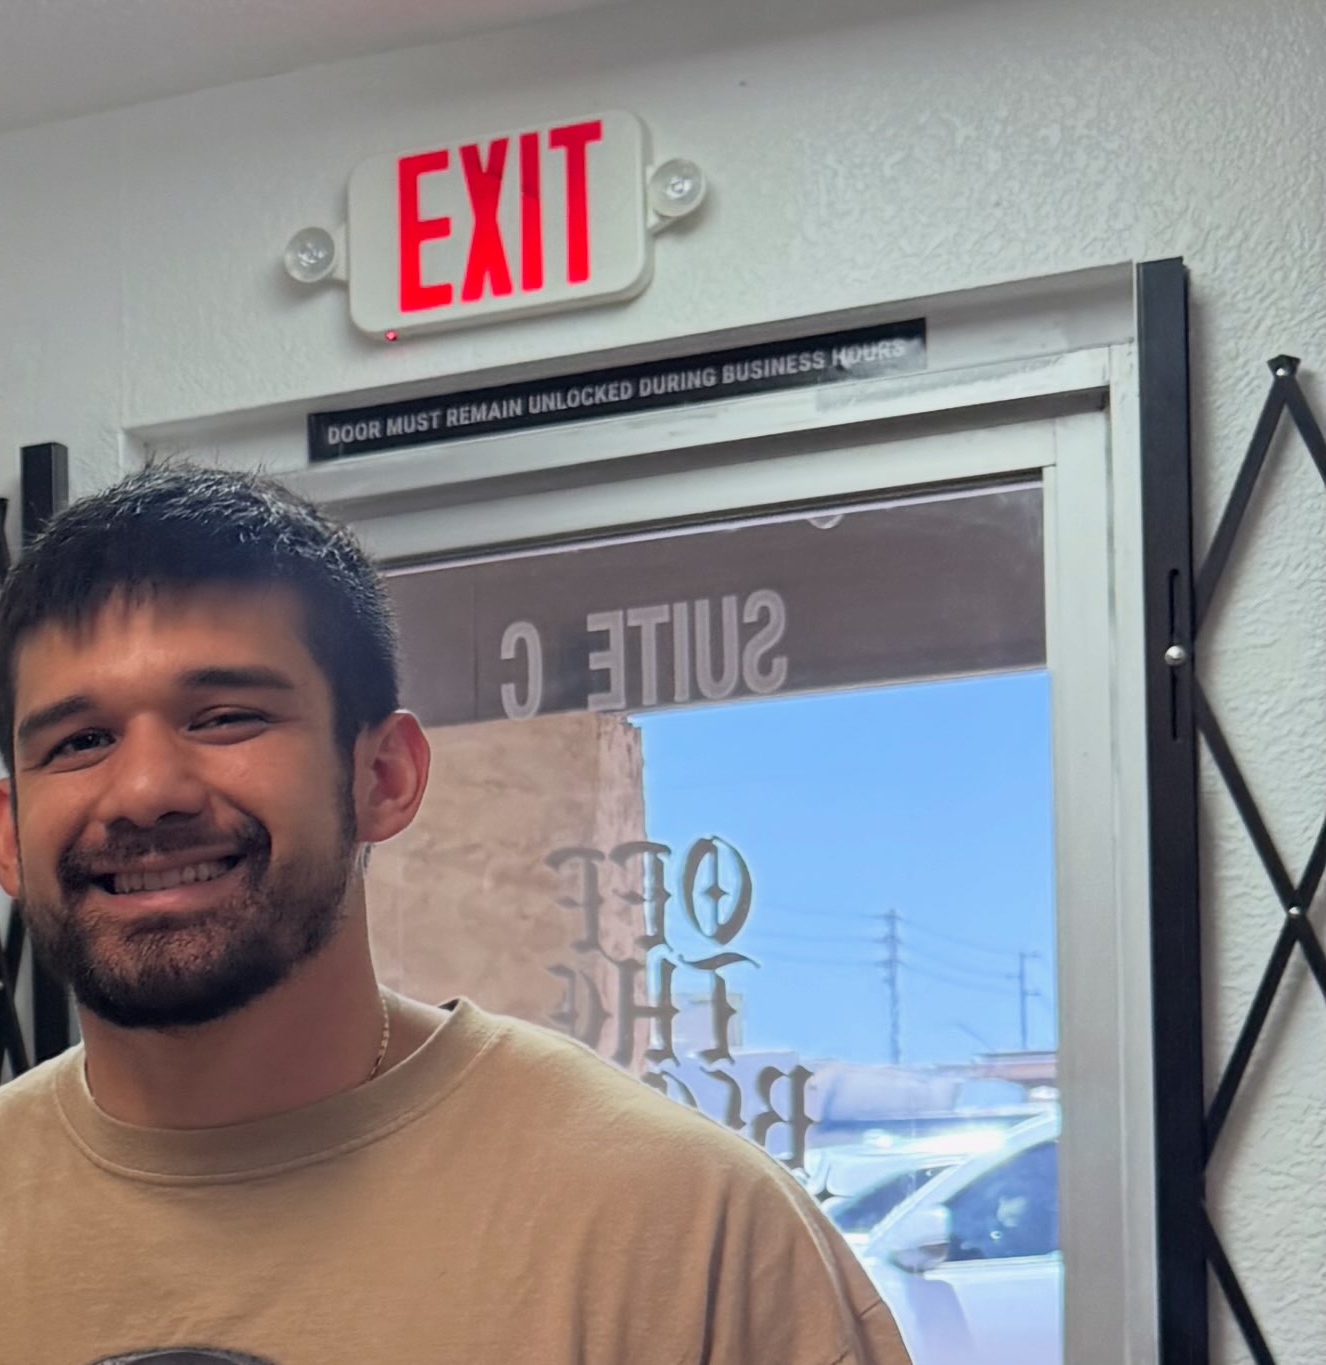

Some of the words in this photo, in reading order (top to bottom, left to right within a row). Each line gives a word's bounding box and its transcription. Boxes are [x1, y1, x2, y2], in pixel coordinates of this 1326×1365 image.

[396, 119, 603, 313] EXIT
[328, 420, 382, 445] DOOR
[386, 411, 441, 437] MUST
[446, 397, 522, 427] REMAIN
[528, 378, 633, 415] UNLOCKED
[639, 367, 716, 398] DURING
[722, 350, 825, 385] BUSINESS
[832, 338, 905, 367] HOURS
